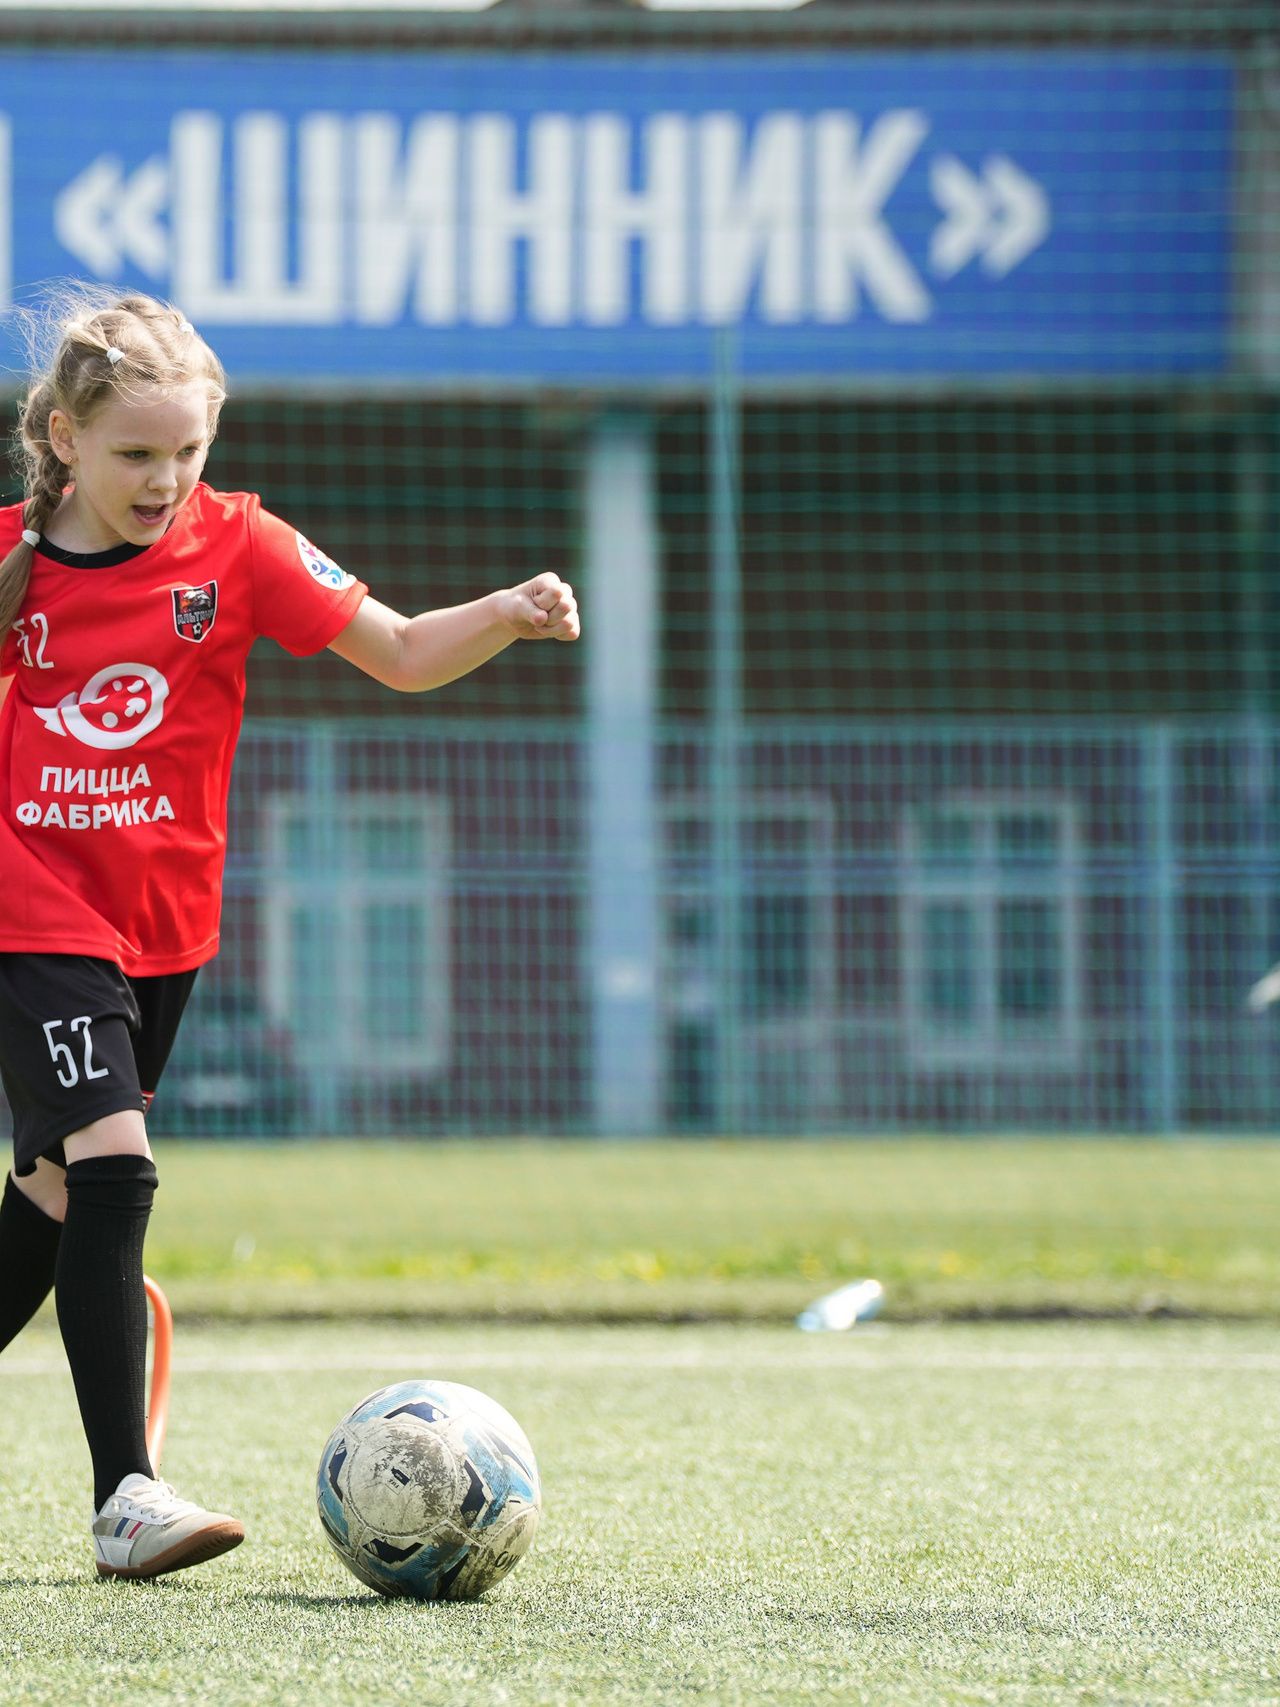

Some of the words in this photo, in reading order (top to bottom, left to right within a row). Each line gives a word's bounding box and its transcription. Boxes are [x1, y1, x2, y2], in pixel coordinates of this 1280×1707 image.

[56, 110, 1048, 325] «ШИННИК»
[12, 612, 55, 670] 52
[39, 763, 152, 797] ПИЦЦА
[15, 795, 176, 830] ФАБРИКА
[42, 1015, 109, 1088] 52
